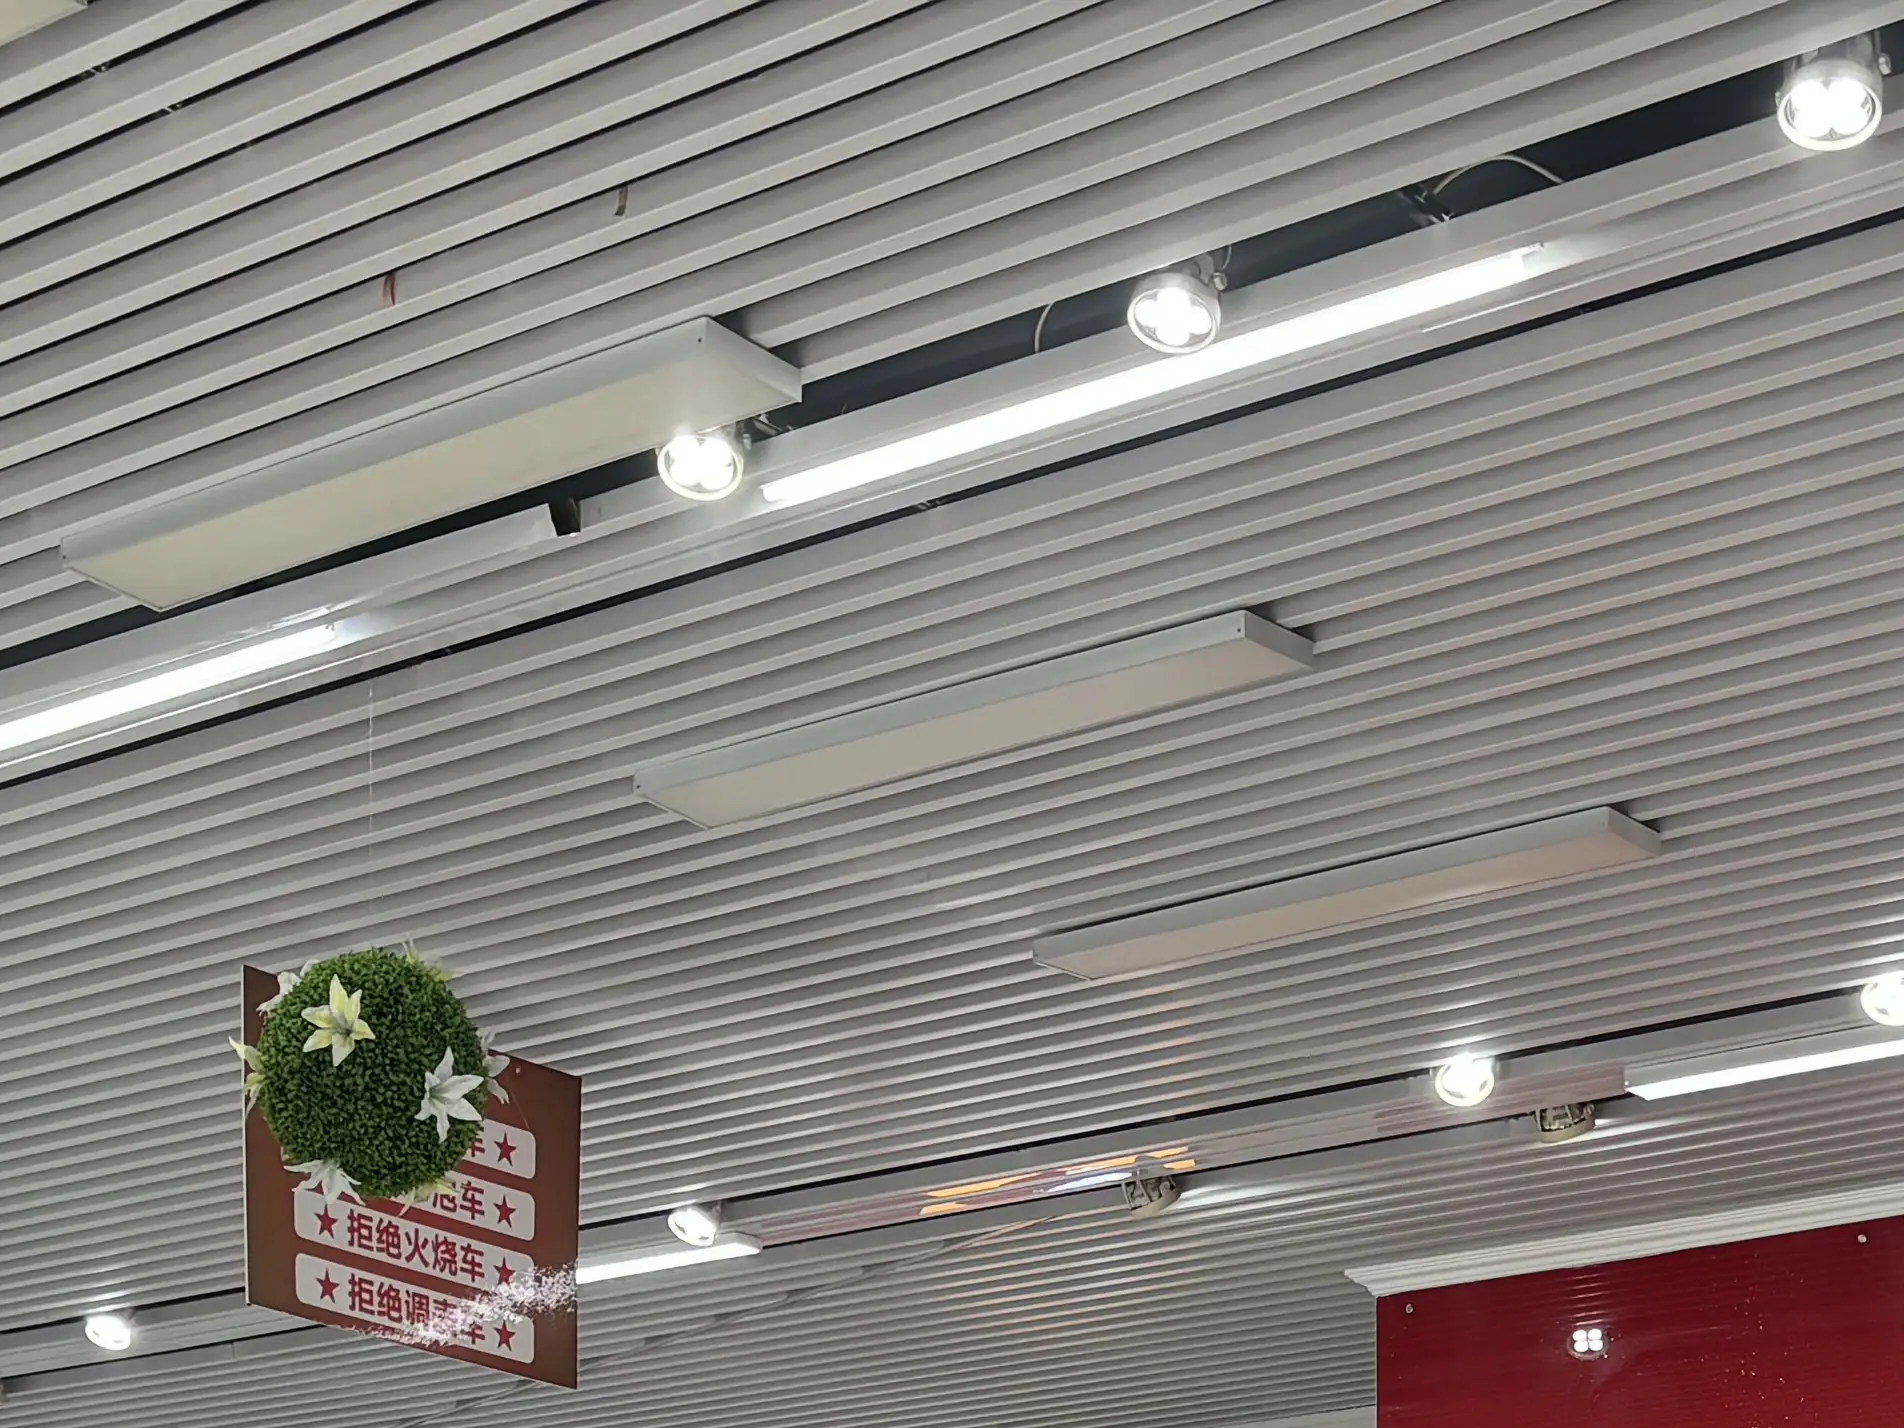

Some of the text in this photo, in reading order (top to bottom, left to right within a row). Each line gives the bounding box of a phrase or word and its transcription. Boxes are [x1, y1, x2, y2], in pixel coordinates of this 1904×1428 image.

[346, 1207, 485, 1284] 拒绝火烧车
